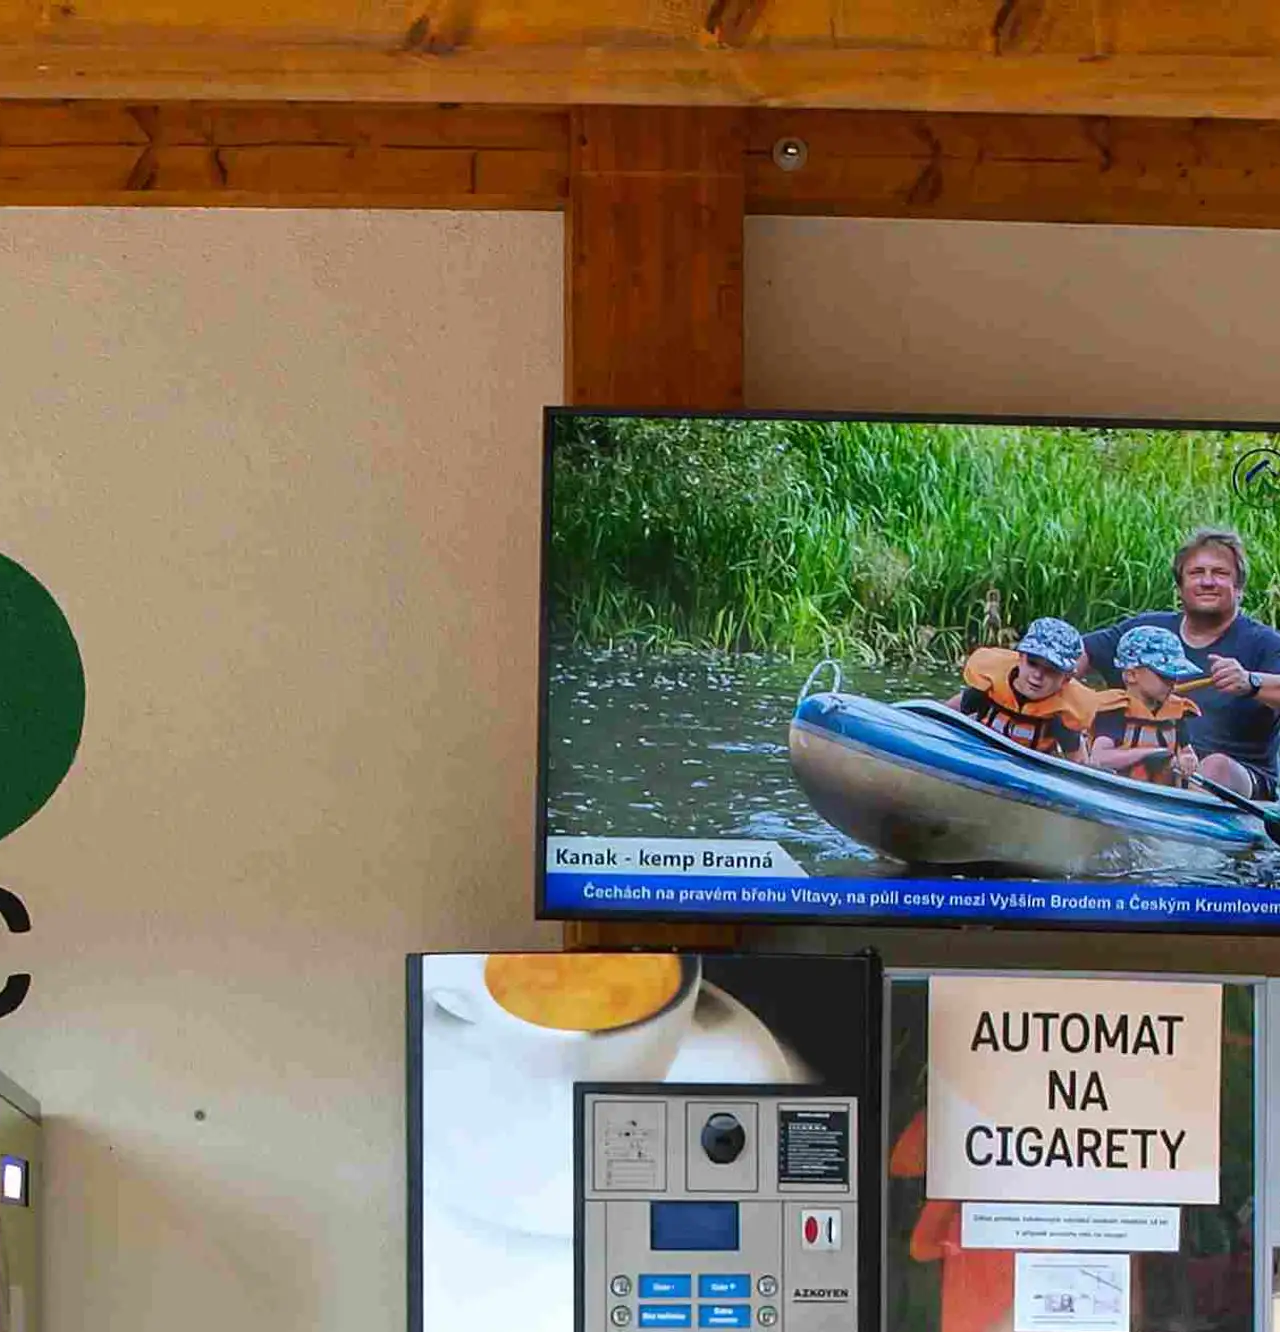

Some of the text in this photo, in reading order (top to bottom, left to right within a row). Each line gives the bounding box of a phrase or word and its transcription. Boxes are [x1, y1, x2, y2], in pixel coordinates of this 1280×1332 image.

[555, 848, 617, 867] Kanak
[639, 850, 695, 872] kemp
[702, 851, 774, 870] Branná
[583, 881, 651, 901] Čechách
[656, 889, 675, 901] na
[680, 885, 737, 905] pravém
[741, 885, 787, 903] břehu
[791, 887, 843, 907] Vltavy,
[847, 893, 866, 905] na
[903, 892, 945, 909] cesty
[949, 891, 986, 908] mezi
[989, 891, 1046, 911] Vyšším
[1051, 894, 1111, 911] Brodem
[1116, 900, 1124, 911] a
[1130, 892, 1190, 915] Českým
[970, 1011, 1184, 1056] AUTOMAT
[1047, 1070, 1109, 1111] NA
[965, 1125, 1186, 1170] CIGARETY
